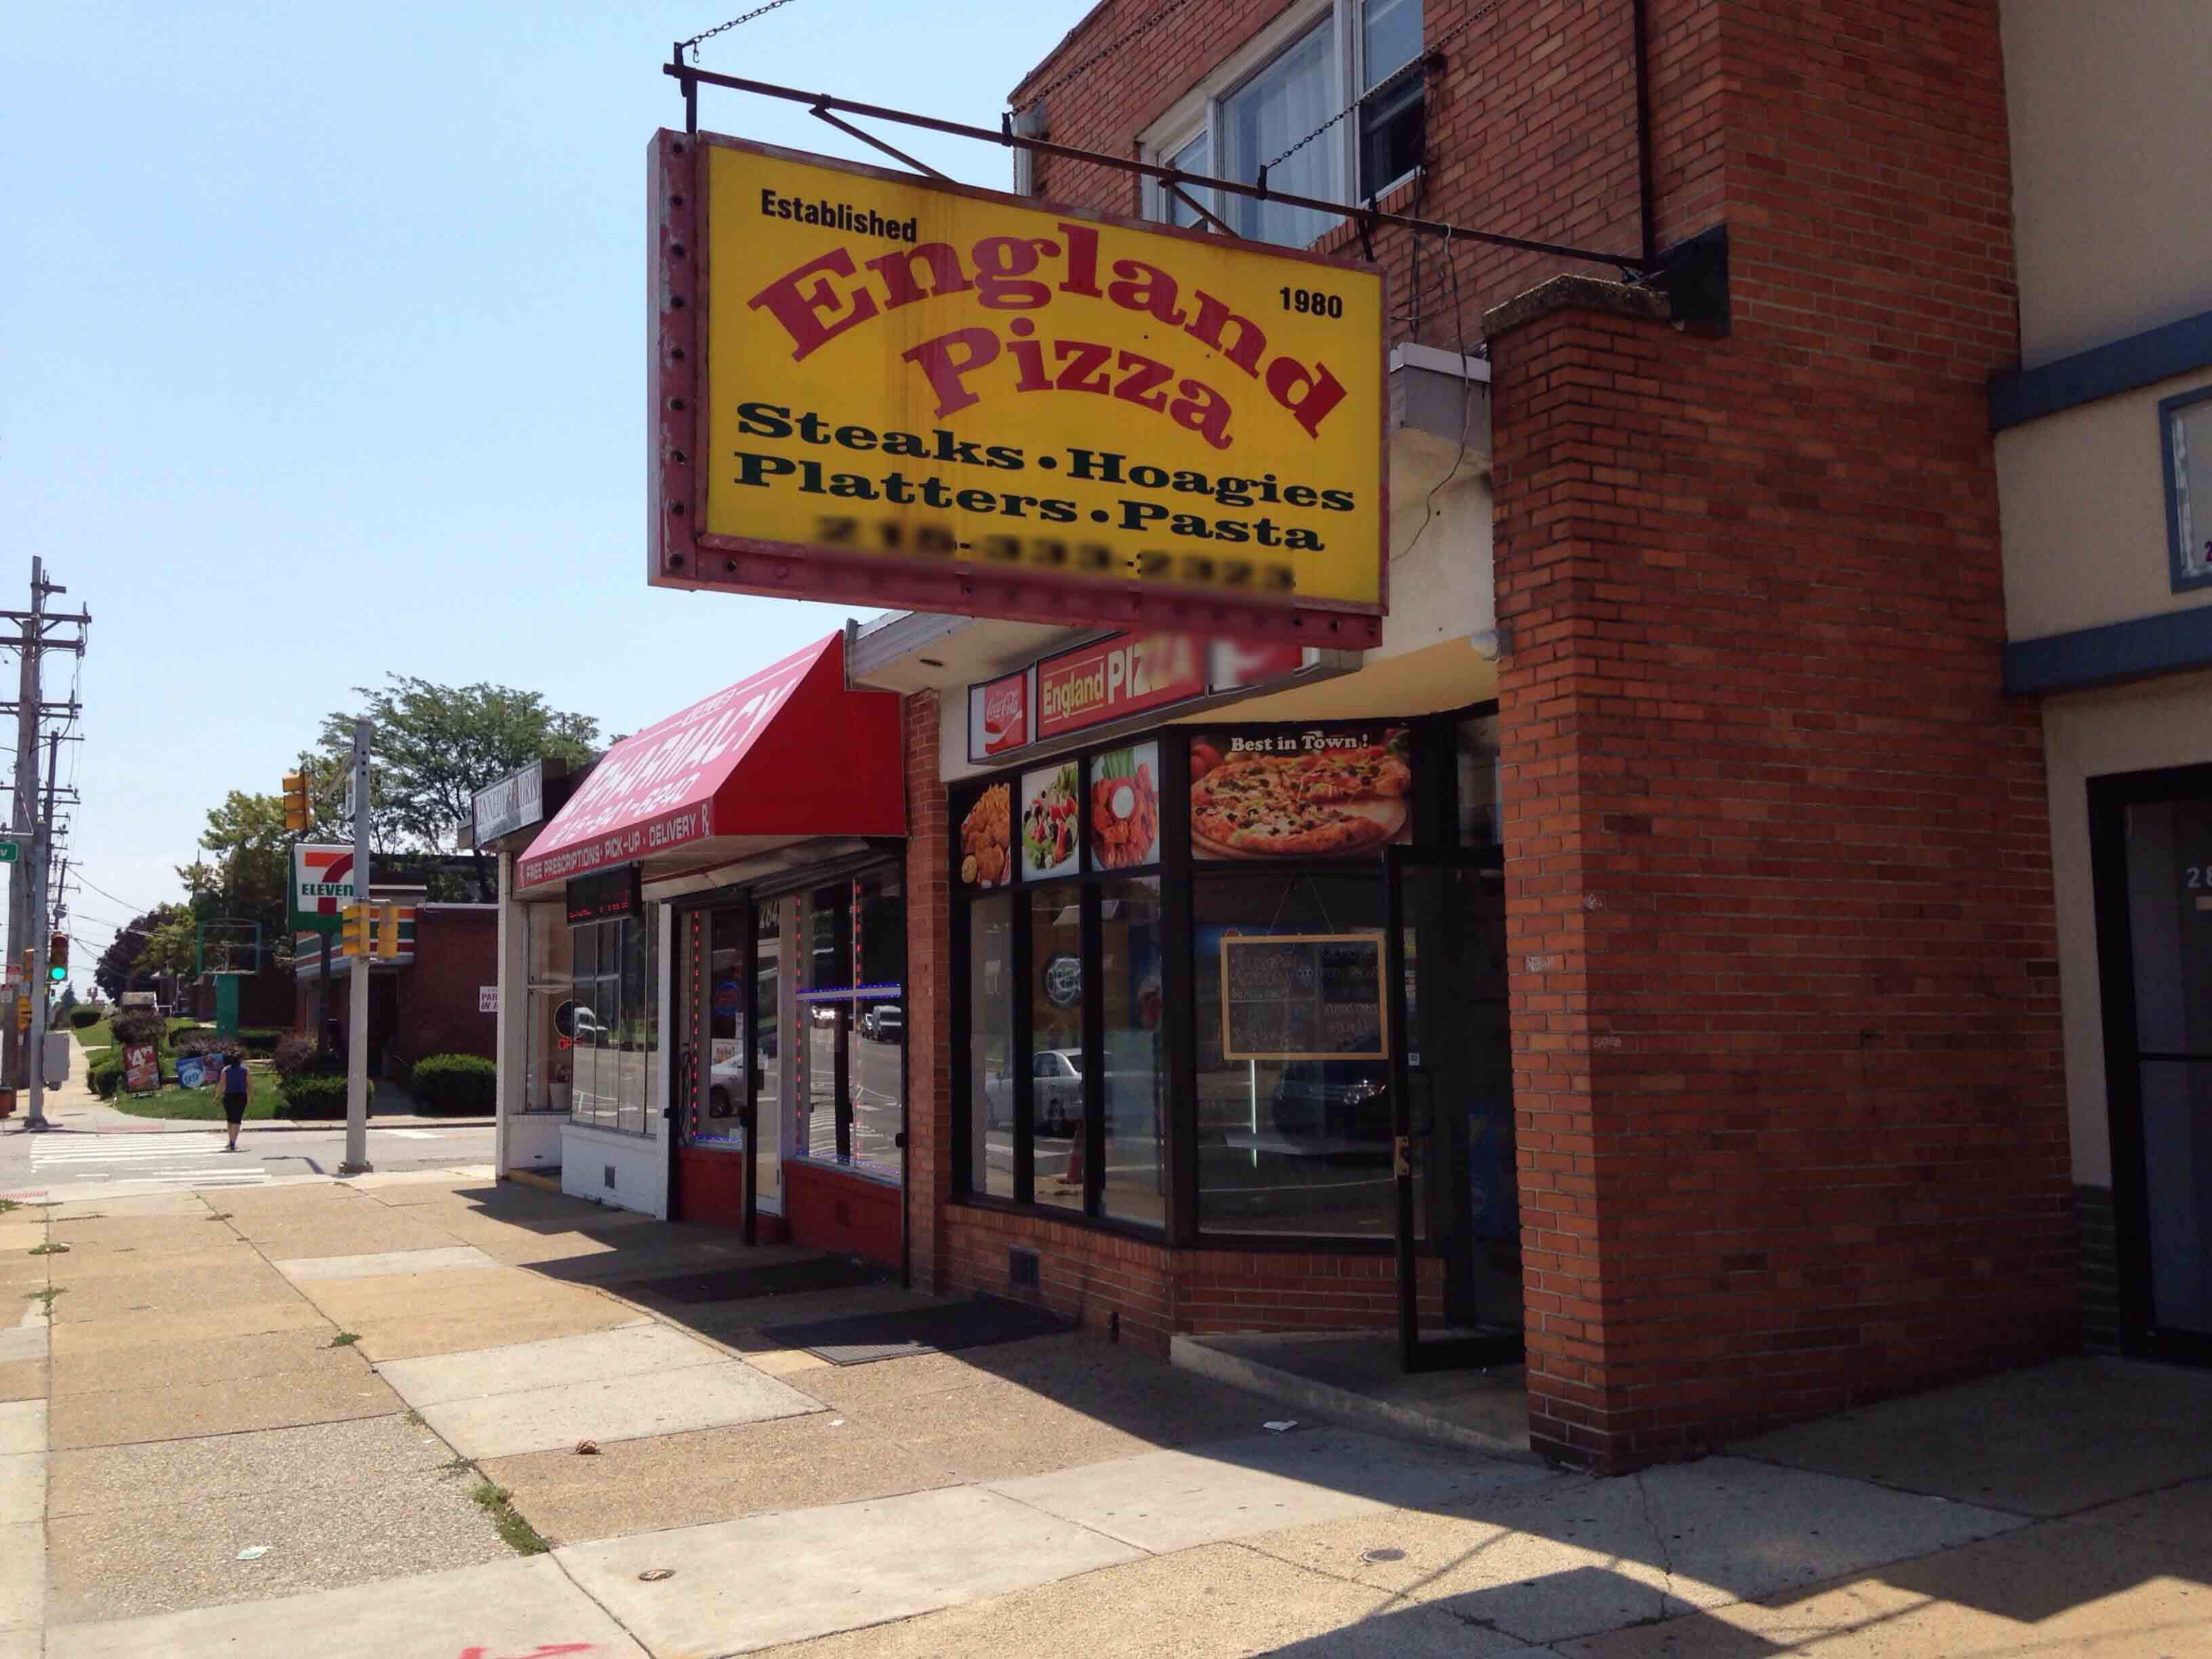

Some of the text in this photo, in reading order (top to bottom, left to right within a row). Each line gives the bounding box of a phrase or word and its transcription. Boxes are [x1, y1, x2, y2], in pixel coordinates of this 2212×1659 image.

[760, 188, 918, 244] Established
[747, 222, 1347, 440] England
[1279, 286, 1343, 319] 1980
[901, 316, 1234, 450] Pizza
[736, 402, 1355, 512] Steaks Hoagies
[733, 451, 1078, 523] Platters
[1117, 499, 1325, 552] Pasta
[1042, 661, 1105, 718] England
[570, 678, 798, 817] PHARMACY
[1231, 737, 1273, 752] Best
[1277, 736, 1297, 750] in
[544, 845, 600, 876] PRESCRIPTIONS
[605, 830, 640, 859] PICK-UP
[649, 813, 697, 848] DELIVERY
